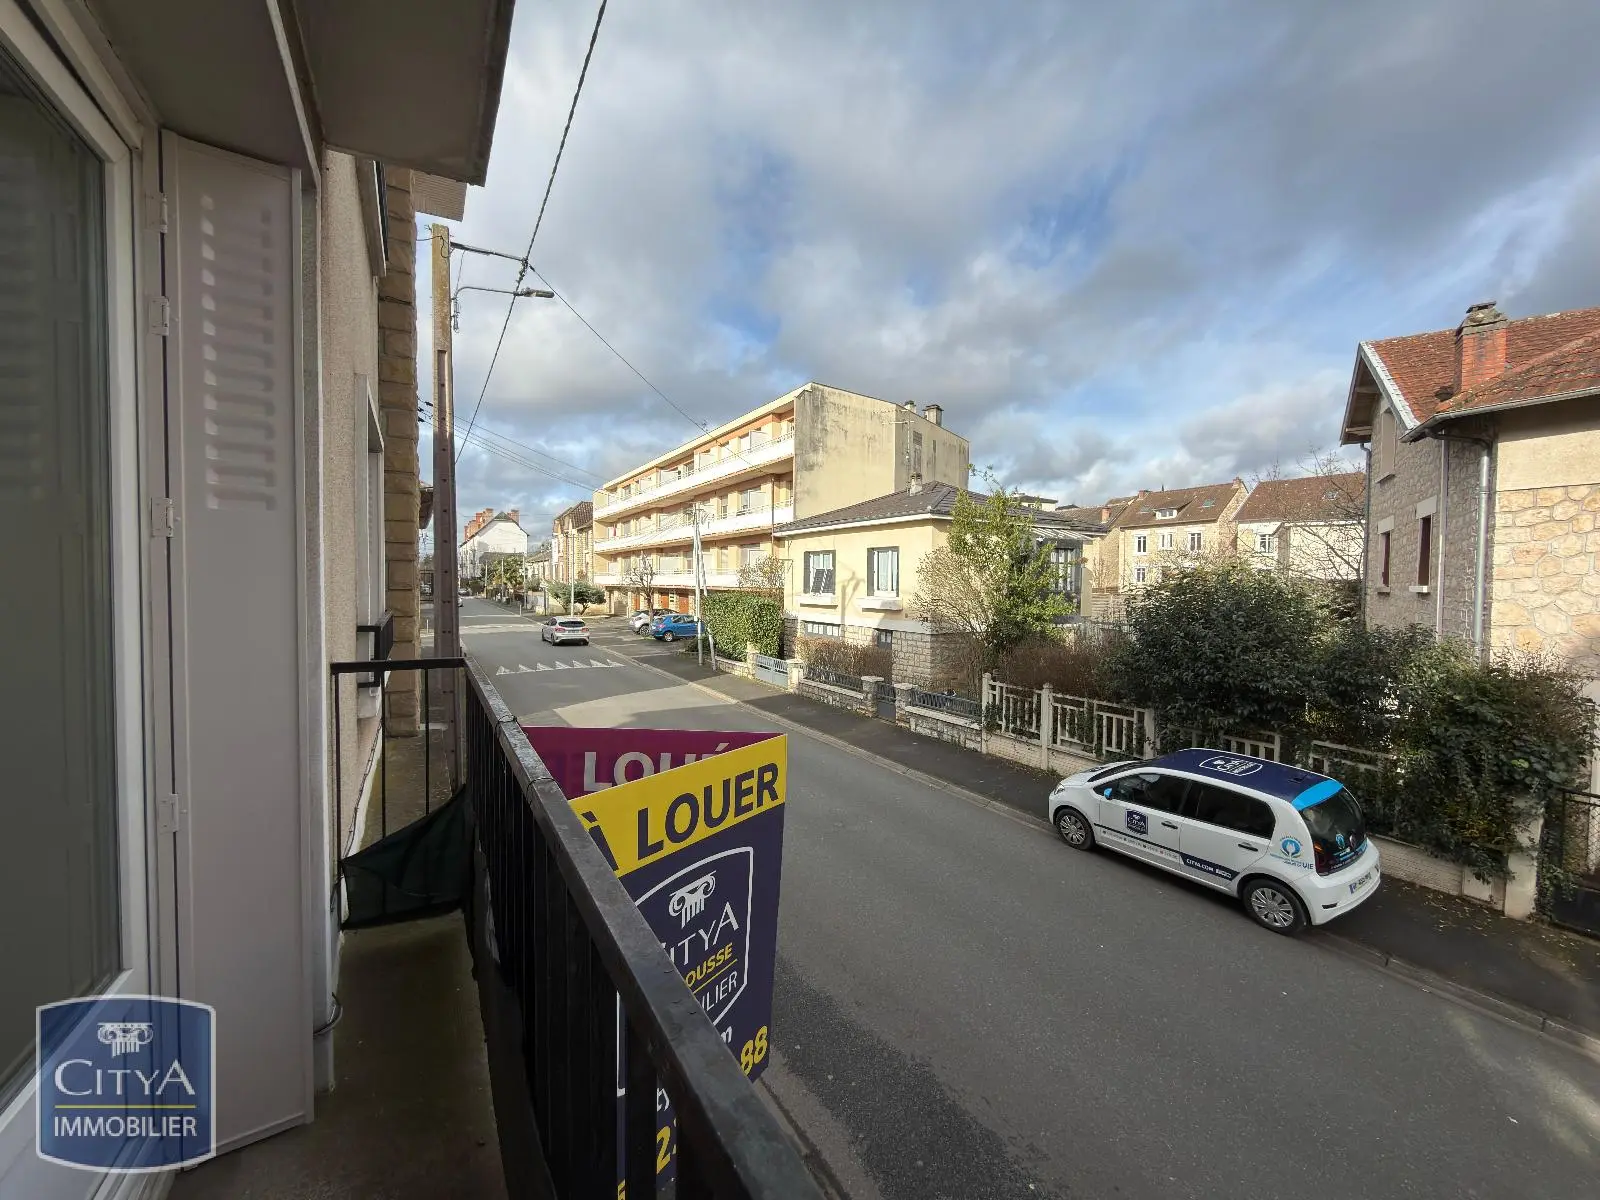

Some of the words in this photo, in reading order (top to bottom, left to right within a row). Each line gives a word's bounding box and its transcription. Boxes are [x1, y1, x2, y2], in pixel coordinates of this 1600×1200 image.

[584, 743, 729, 792] LO
[637, 762, 779, 861] LOUER
[661, 901, 739, 966] ITYA
